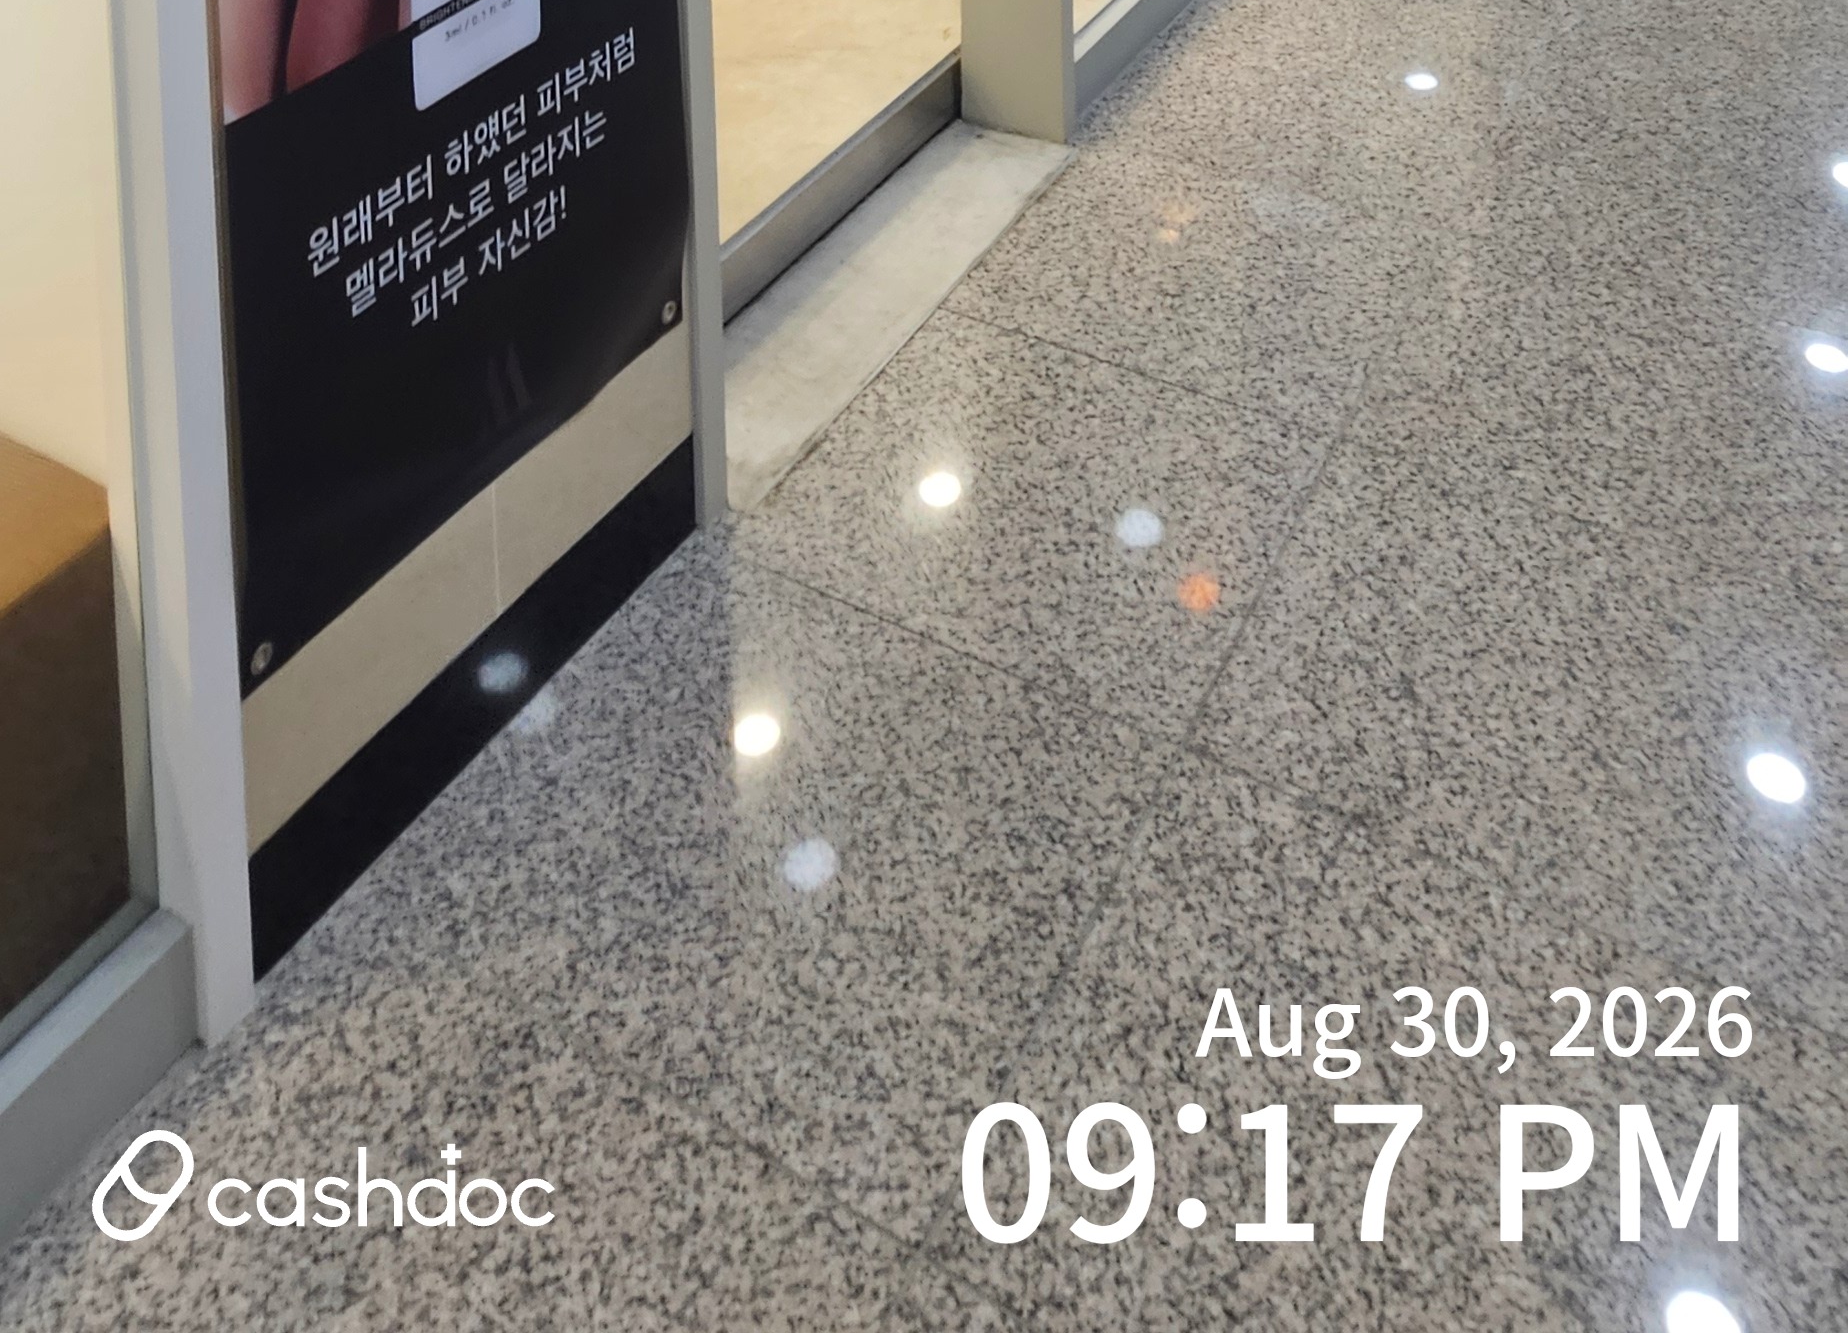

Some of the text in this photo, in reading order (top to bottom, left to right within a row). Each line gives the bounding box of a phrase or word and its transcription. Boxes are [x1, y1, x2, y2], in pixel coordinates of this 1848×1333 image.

[307, 27, 636, 277] 원래부터 하얬던 피부처럼
[345, 109, 607, 318] 멜라듀스로 달라지는
[411, 185, 567, 327] 피부 자신감!
